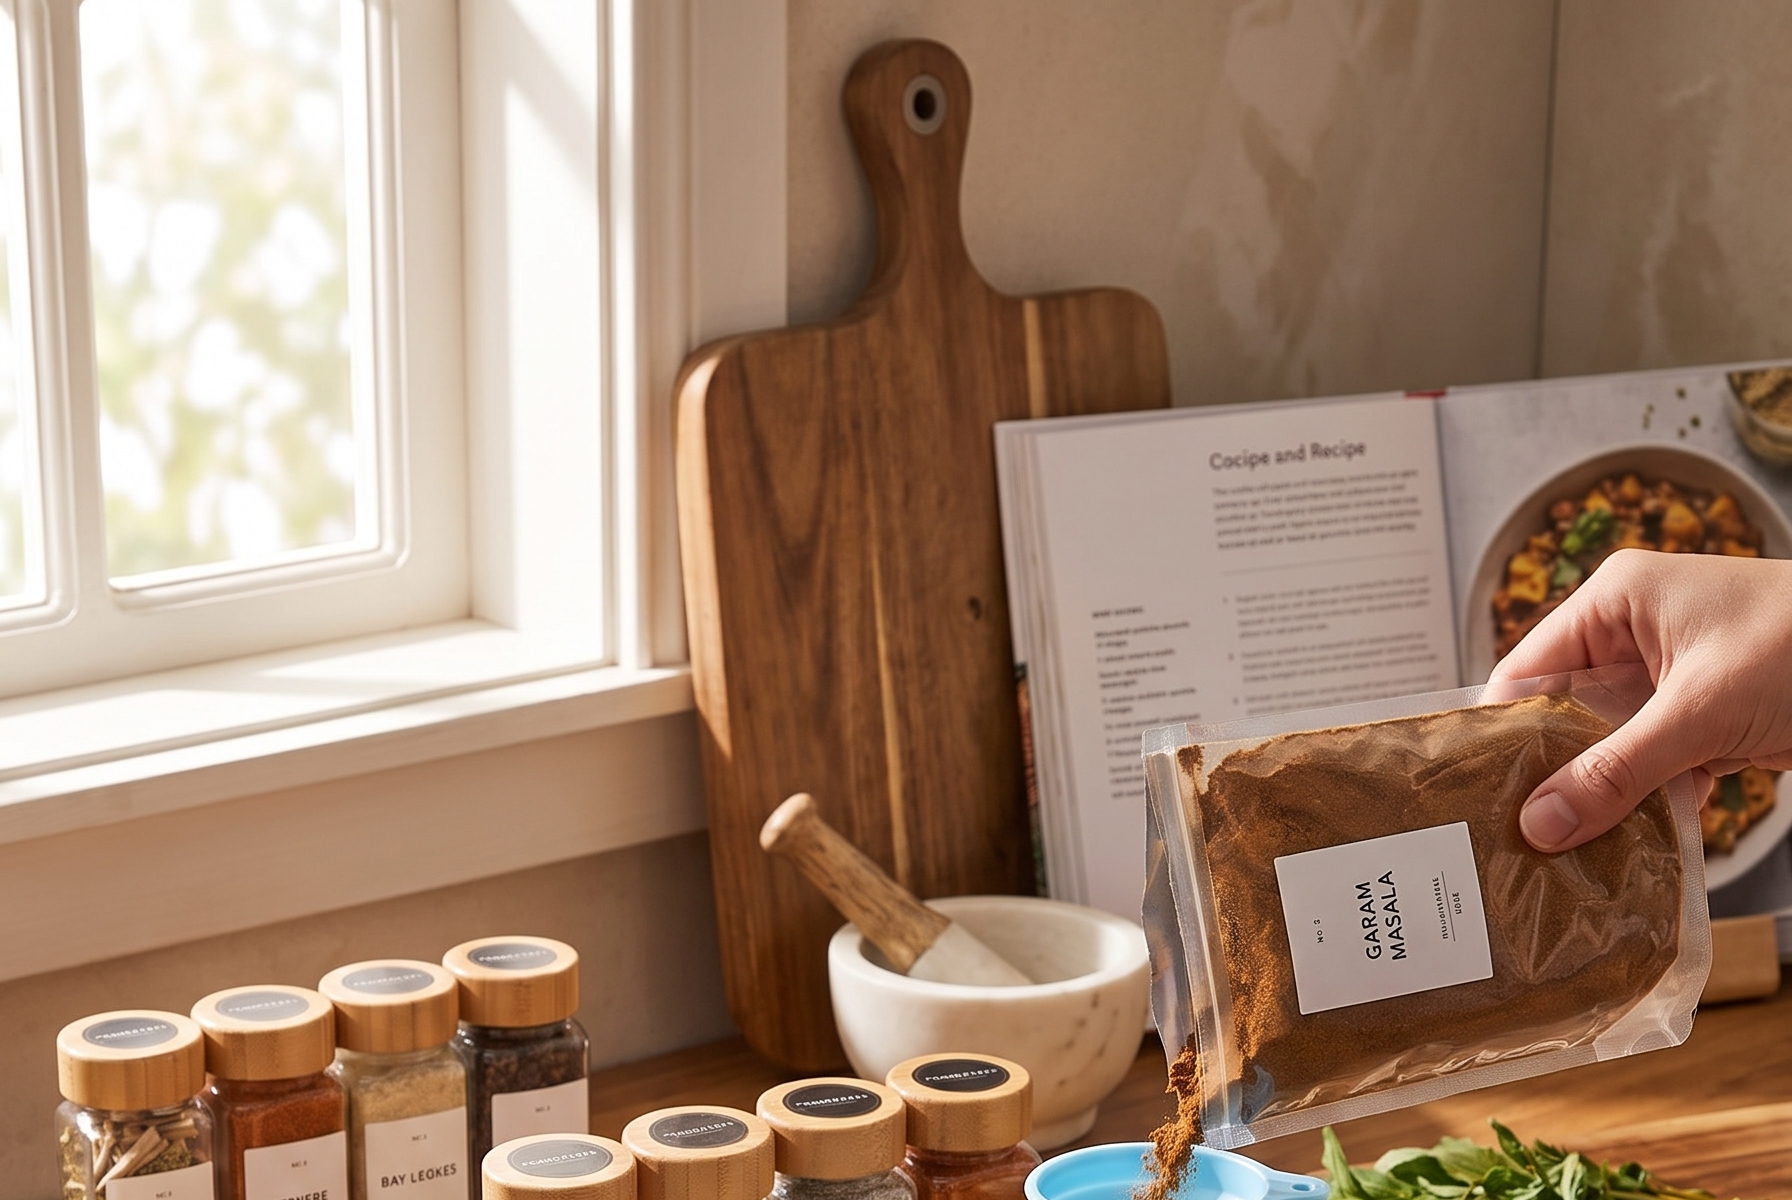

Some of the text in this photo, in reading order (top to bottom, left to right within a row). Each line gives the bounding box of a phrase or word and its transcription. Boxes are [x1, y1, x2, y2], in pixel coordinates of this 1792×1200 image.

[1275, 443, 1307, 465] and
[1310, 439, 1367, 462] Recipe
[1355, 881, 1382, 960] GARAM
[1378, 870, 1407, 961] MASALA
[381, 1174, 406, 1189] BAY
